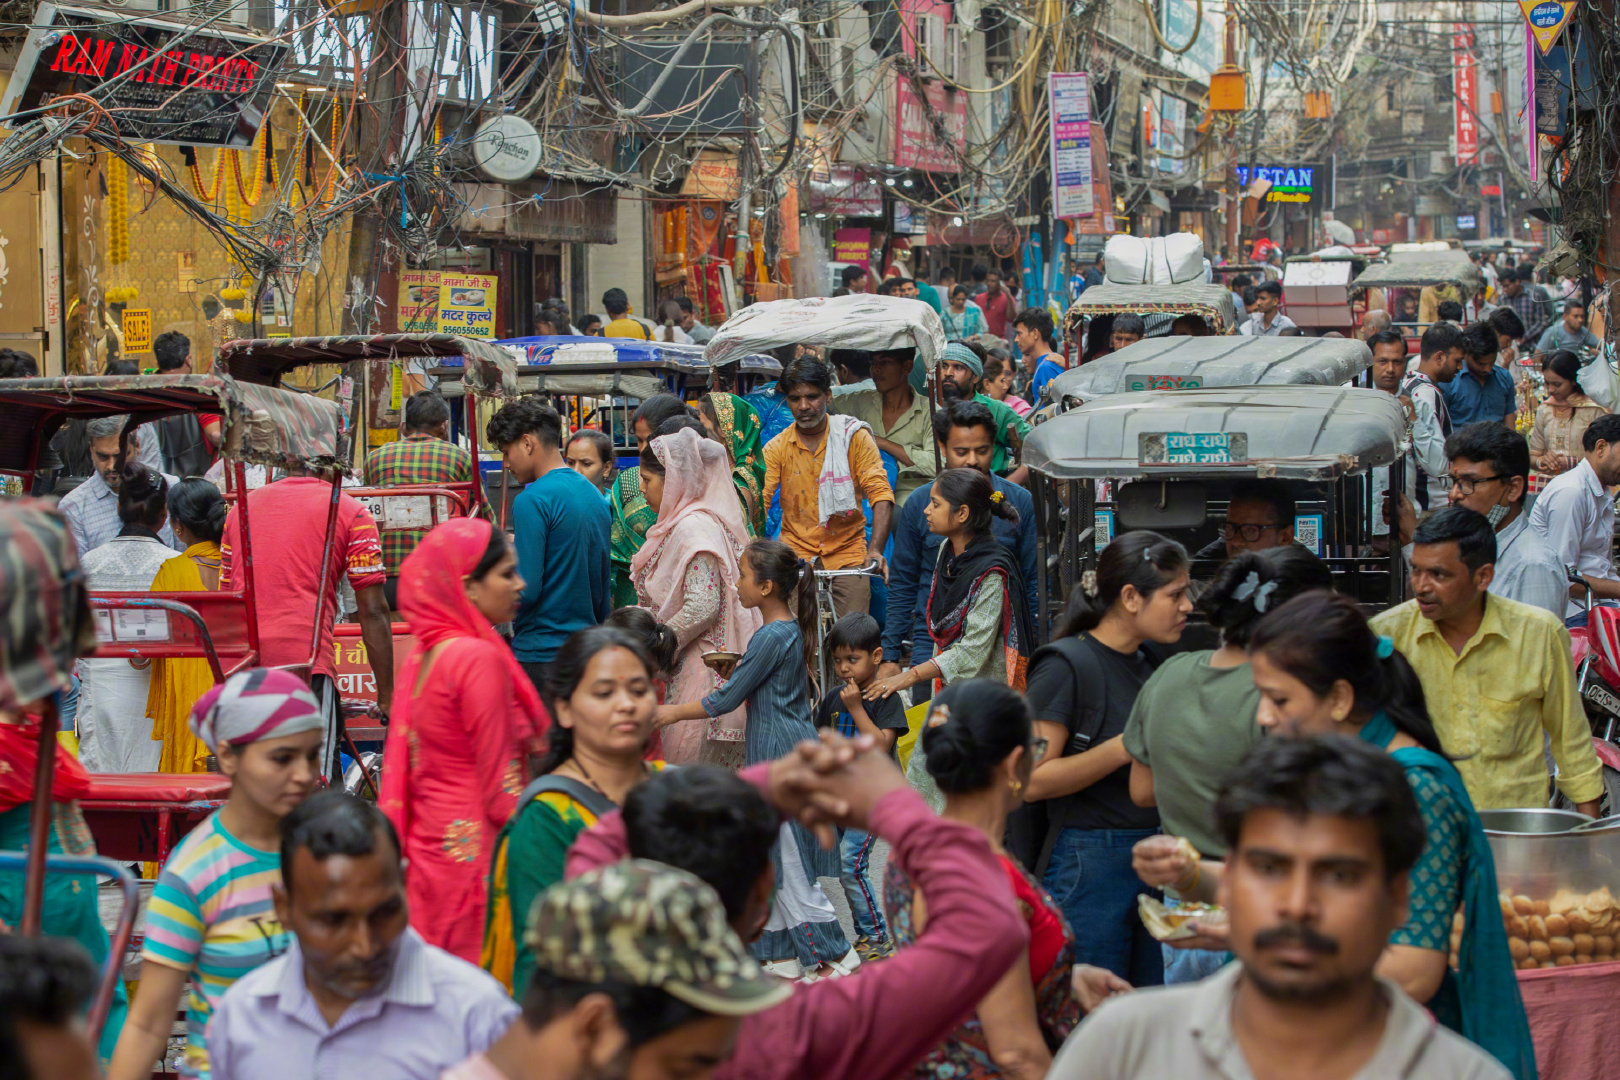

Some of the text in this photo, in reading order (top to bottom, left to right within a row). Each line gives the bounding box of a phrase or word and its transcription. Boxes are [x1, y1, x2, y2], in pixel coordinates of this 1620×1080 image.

[51, 35, 113, 77] RAM
[113, 44, 183, 86] NATH
[180, 53, 259, 94] PRINTS
[443, 277, 492, 289] मामा जी के
[441, 309, 462, 321] मटर
[127, 320, 146, 342] SALE
[443, 325, 489, 336] 9560550652
[1169, 435, 1229, 448] राधे राधे
